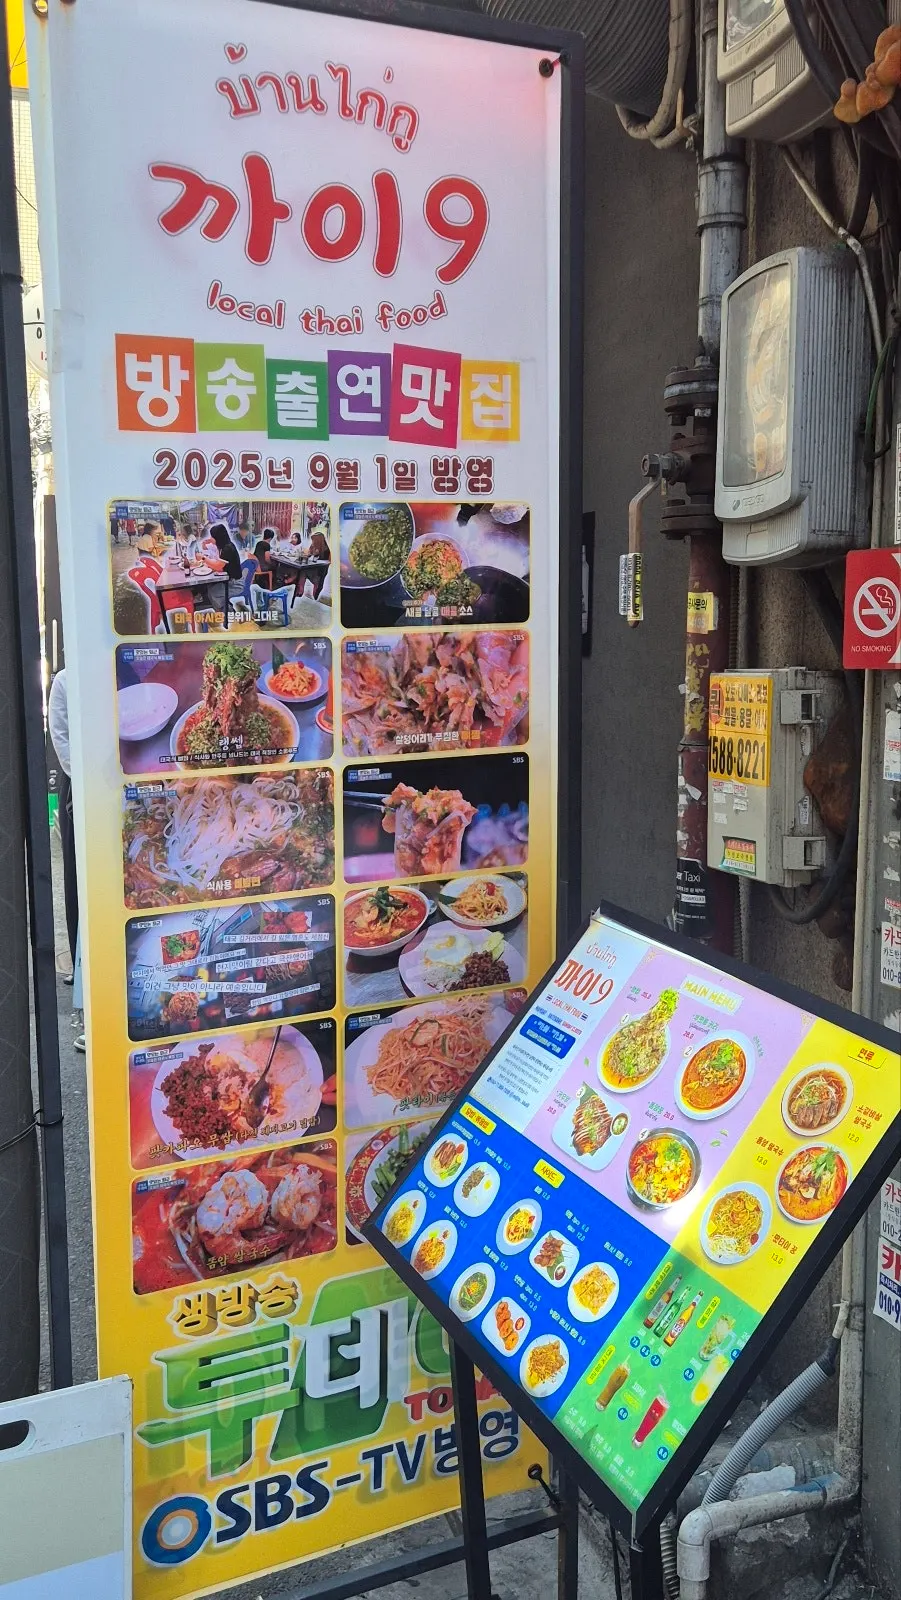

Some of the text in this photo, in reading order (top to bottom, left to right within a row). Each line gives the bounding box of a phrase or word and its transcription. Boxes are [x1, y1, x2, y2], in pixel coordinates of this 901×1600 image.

[206, 281, 449, 336] local thai food
[153, 448, 496, 496] 2025년 9월 1일 방영
[312, 506, 326, 514] SBS
[254, 610, 279, 622] 그대로
[460, 606, 473, 616] 소스
[314, 642, 326, 650] SBS
[684, 870, 700, 882] Taxi
[318, 898, 330, 906] SBS
[164, 982, 180, 991] 그냥
[226, 983, 265, 992] 예술입니다
[684, 980, 737, 1012] MAIN MENU
[319, 1022, 332, 1030] SBS
[854, 1116, 872, 1130] 쌀국수
[848, 1132, 860, 1143] 12.0
[767, 1142, 785, 1156] 쌀국수
[756, 1156, 768, 1166] 13.0
[540, 1166, 558, 1182] 사이드
[772, 1253, 784, 1264] 13.0
[175, 1276, 299, 1334] 생방송
